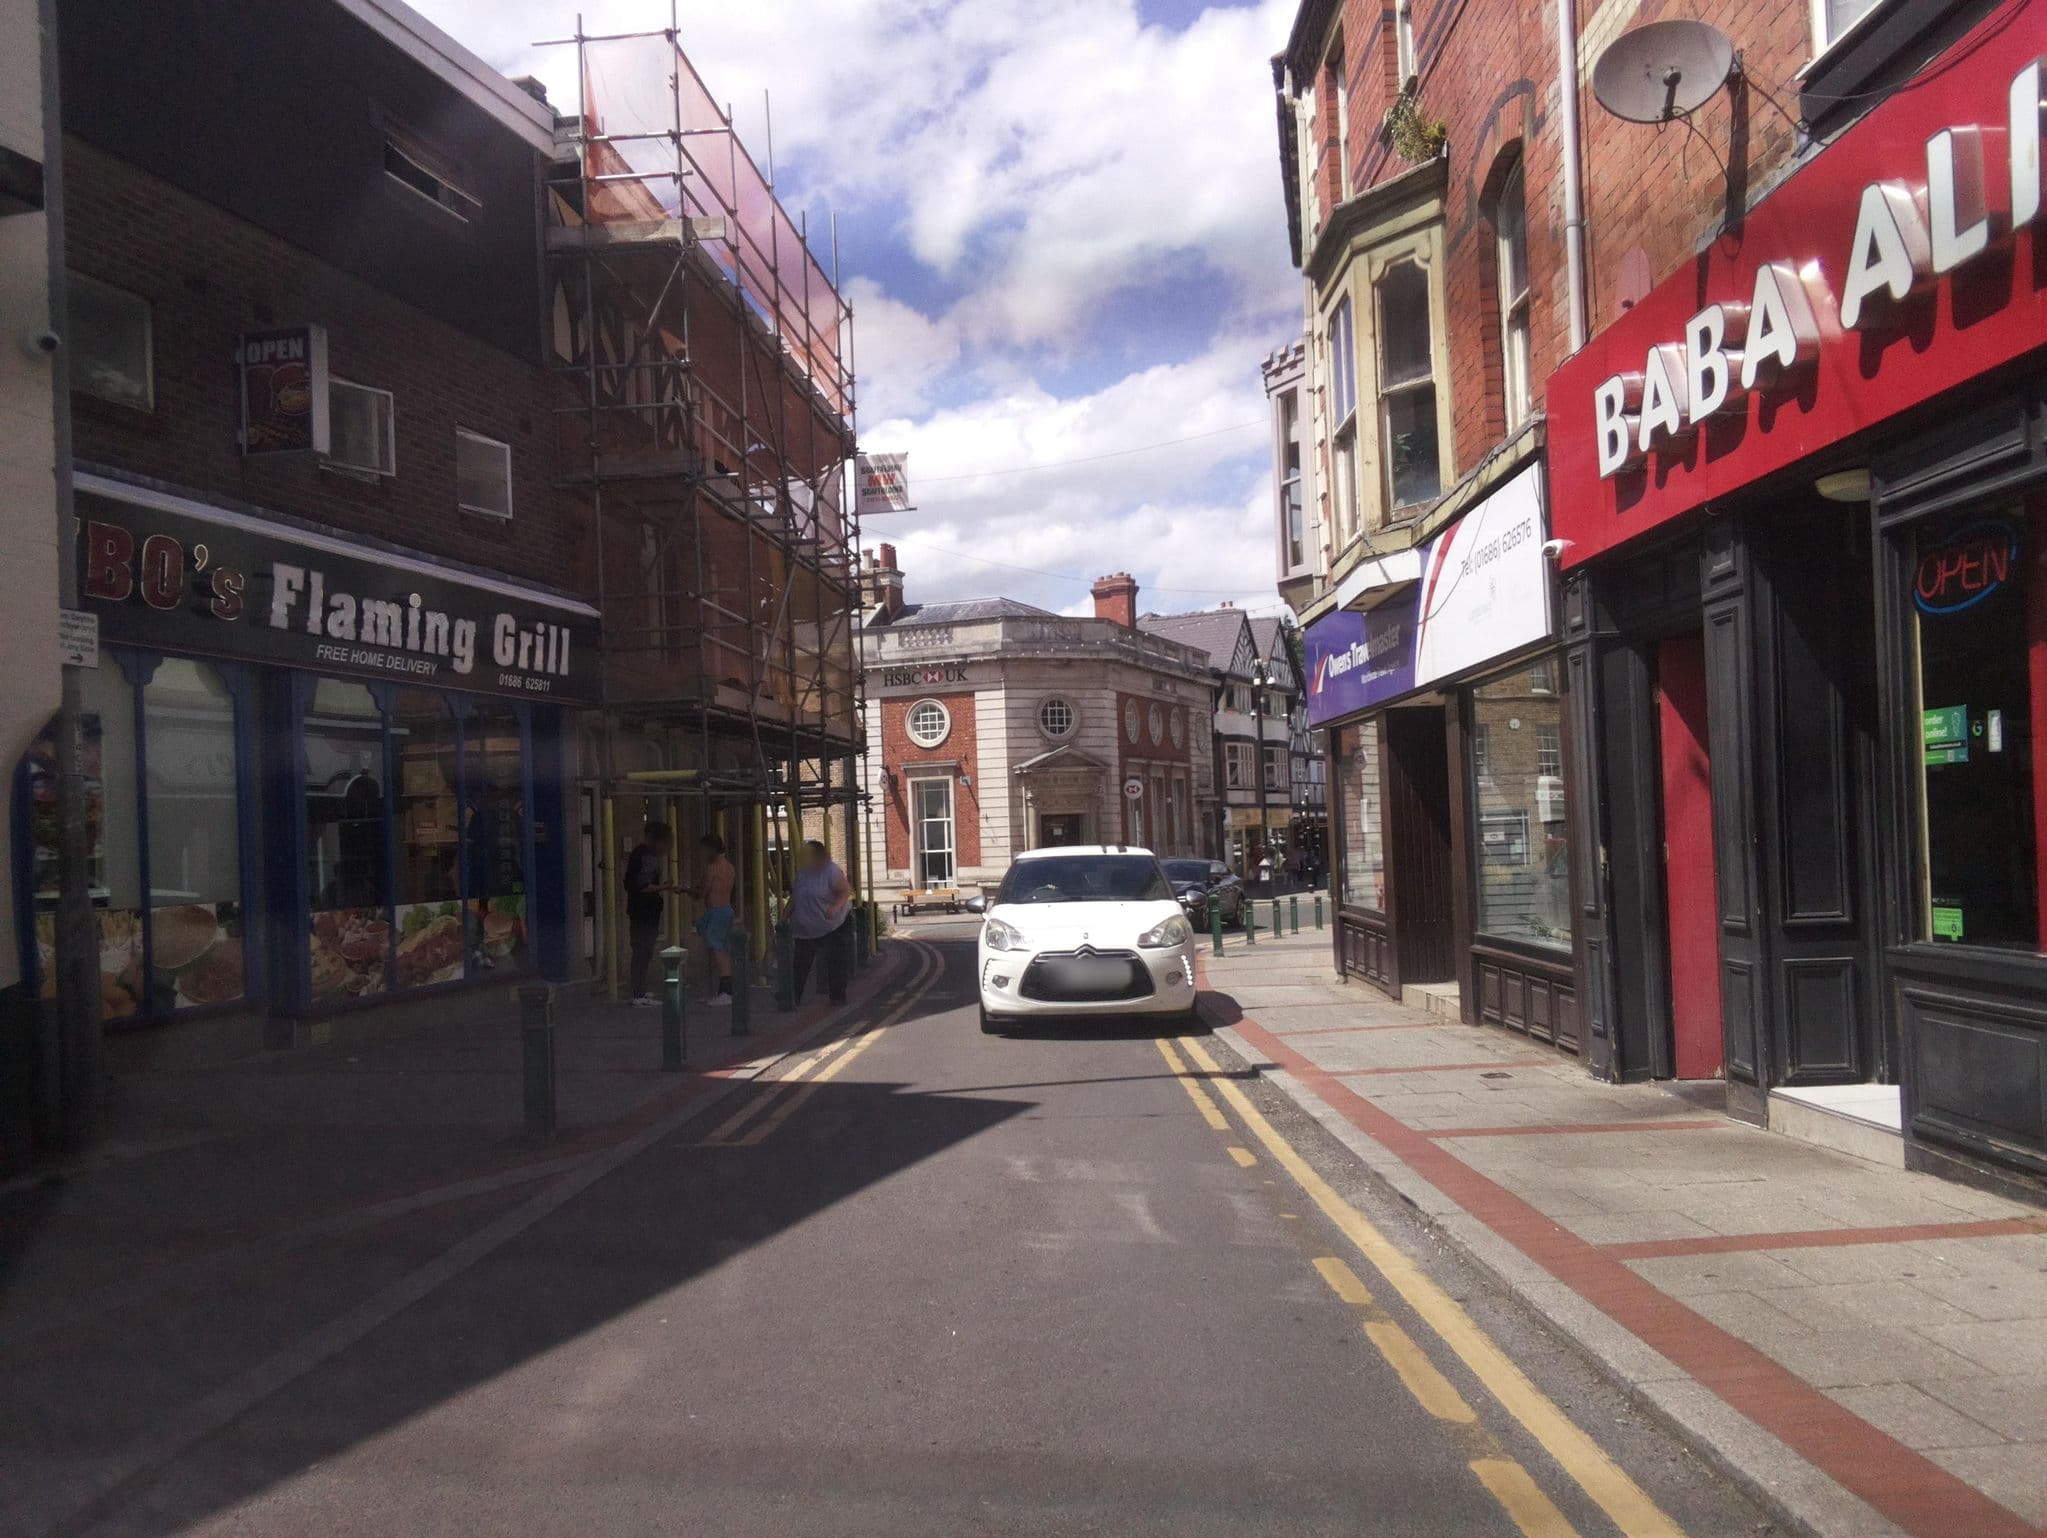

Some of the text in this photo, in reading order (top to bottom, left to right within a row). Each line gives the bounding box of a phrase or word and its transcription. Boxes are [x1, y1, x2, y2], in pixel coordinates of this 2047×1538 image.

[1594, 57, 2042, 480] BABA ALI
[247, 335, 304, 362] OPEN
[1474, 539, 1501, 575] (01686)
[1502, 517, 1533, 553] 626576
[1917, 536, 2009, 600] OPEN
[71, 516, 570, 677] BO's Flaming Grill
[315, 644, 439, 677] FREE HOME DELIVERY
[498, 673, 522, 688] 01686
[884, 669, 968, 687] HSBC UK
